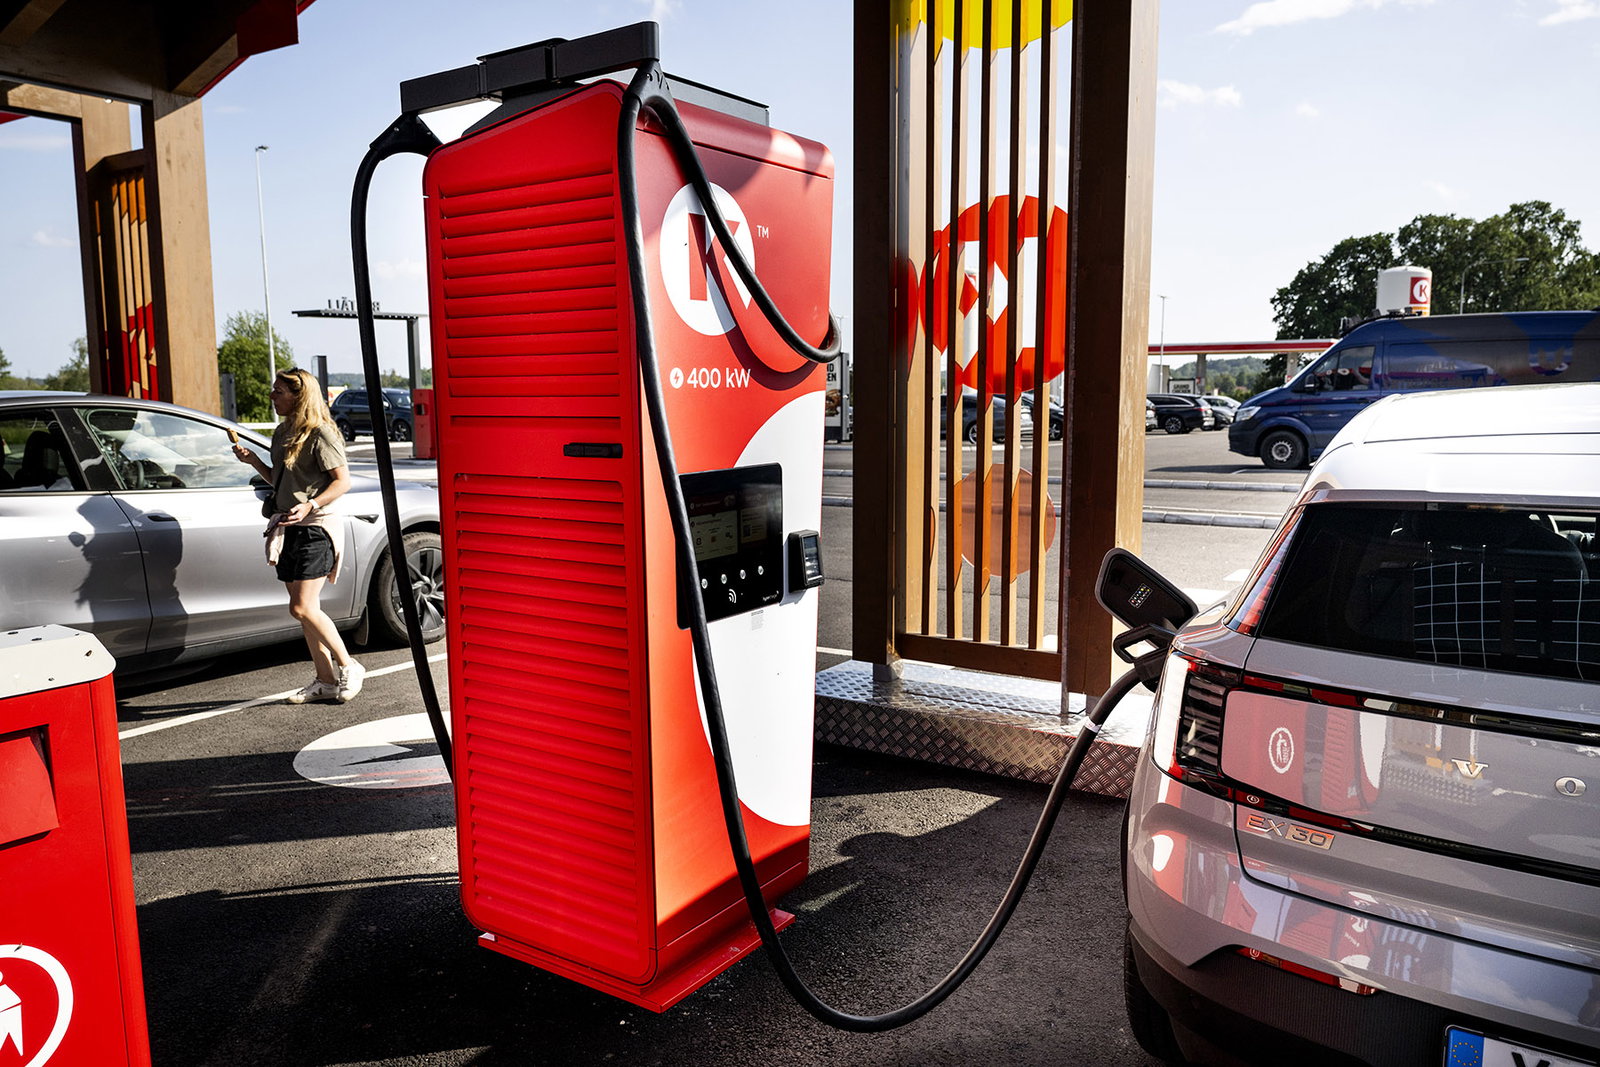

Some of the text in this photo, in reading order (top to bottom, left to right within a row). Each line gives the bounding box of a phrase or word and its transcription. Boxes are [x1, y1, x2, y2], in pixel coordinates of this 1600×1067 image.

[757, 225, 769, 239] TM
[687, 367, 751, 389] 400 kW
